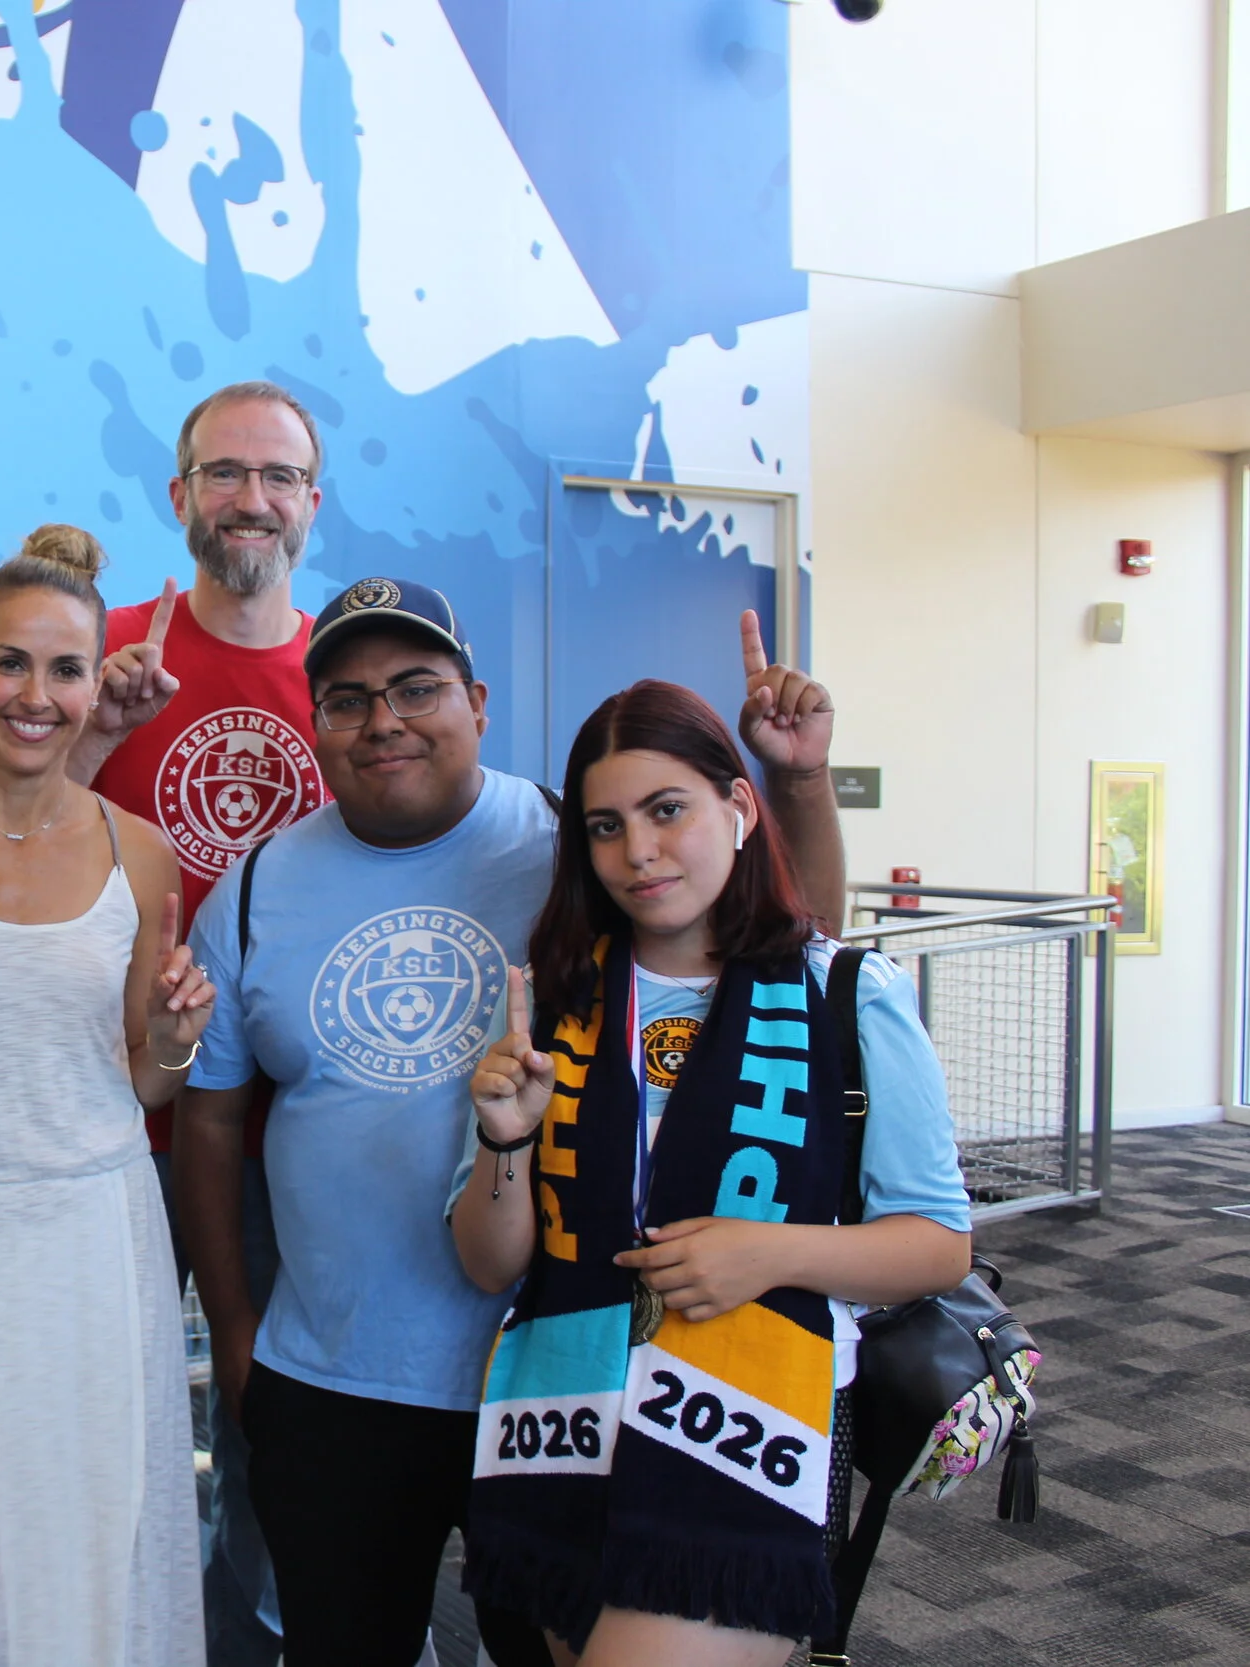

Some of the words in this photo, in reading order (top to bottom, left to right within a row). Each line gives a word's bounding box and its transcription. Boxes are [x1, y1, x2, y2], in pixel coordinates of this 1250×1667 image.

[177, 714, 312, 771] KENSINGTON
[217, 756, 272, 779] KSC
[171, 821, 237, 867] SOCCER
[333, 913, 492, 970] KENSINGTON
[382, 956, 443, 978] KSC
[335, 1035, 417, 1074] SOCCER
[429, 1024, 483, 1068] CLUB
[642, 1018, 702, 1040] KENSING
[663, 1039, 693, 1048] KSC
[499, 1407, 600, 1460] 2026
[638, 1369, 808, 1487] 2026
